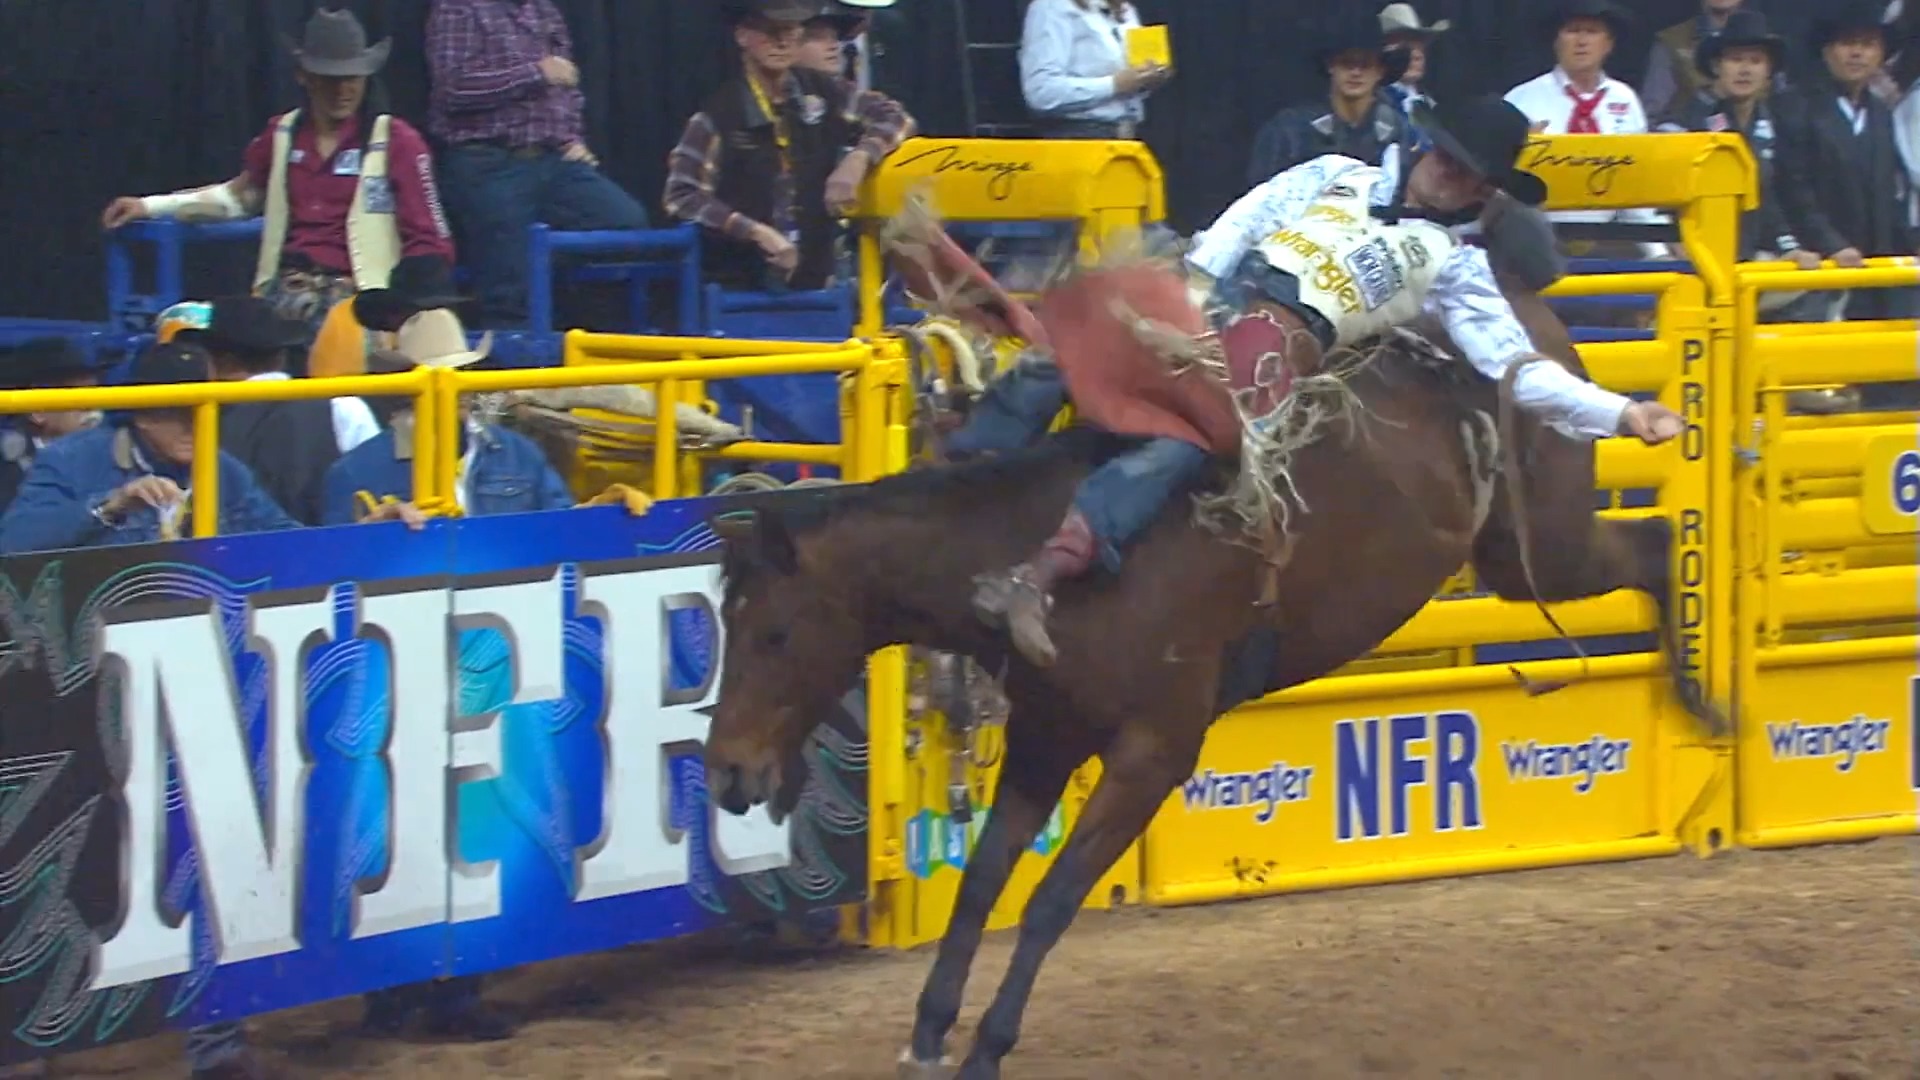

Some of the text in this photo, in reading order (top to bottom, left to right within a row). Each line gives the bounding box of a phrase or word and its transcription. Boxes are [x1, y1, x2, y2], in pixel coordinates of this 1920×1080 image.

[1682, 338, 1704, 461] PRO
[1891, 449, 1920, 515] 6
[88, 562, 792, 991] NFR
[1183, 710, 1632, 843] Wrangler NFR Wrangler
[1765, 713, 1891, 773] Wrangler
